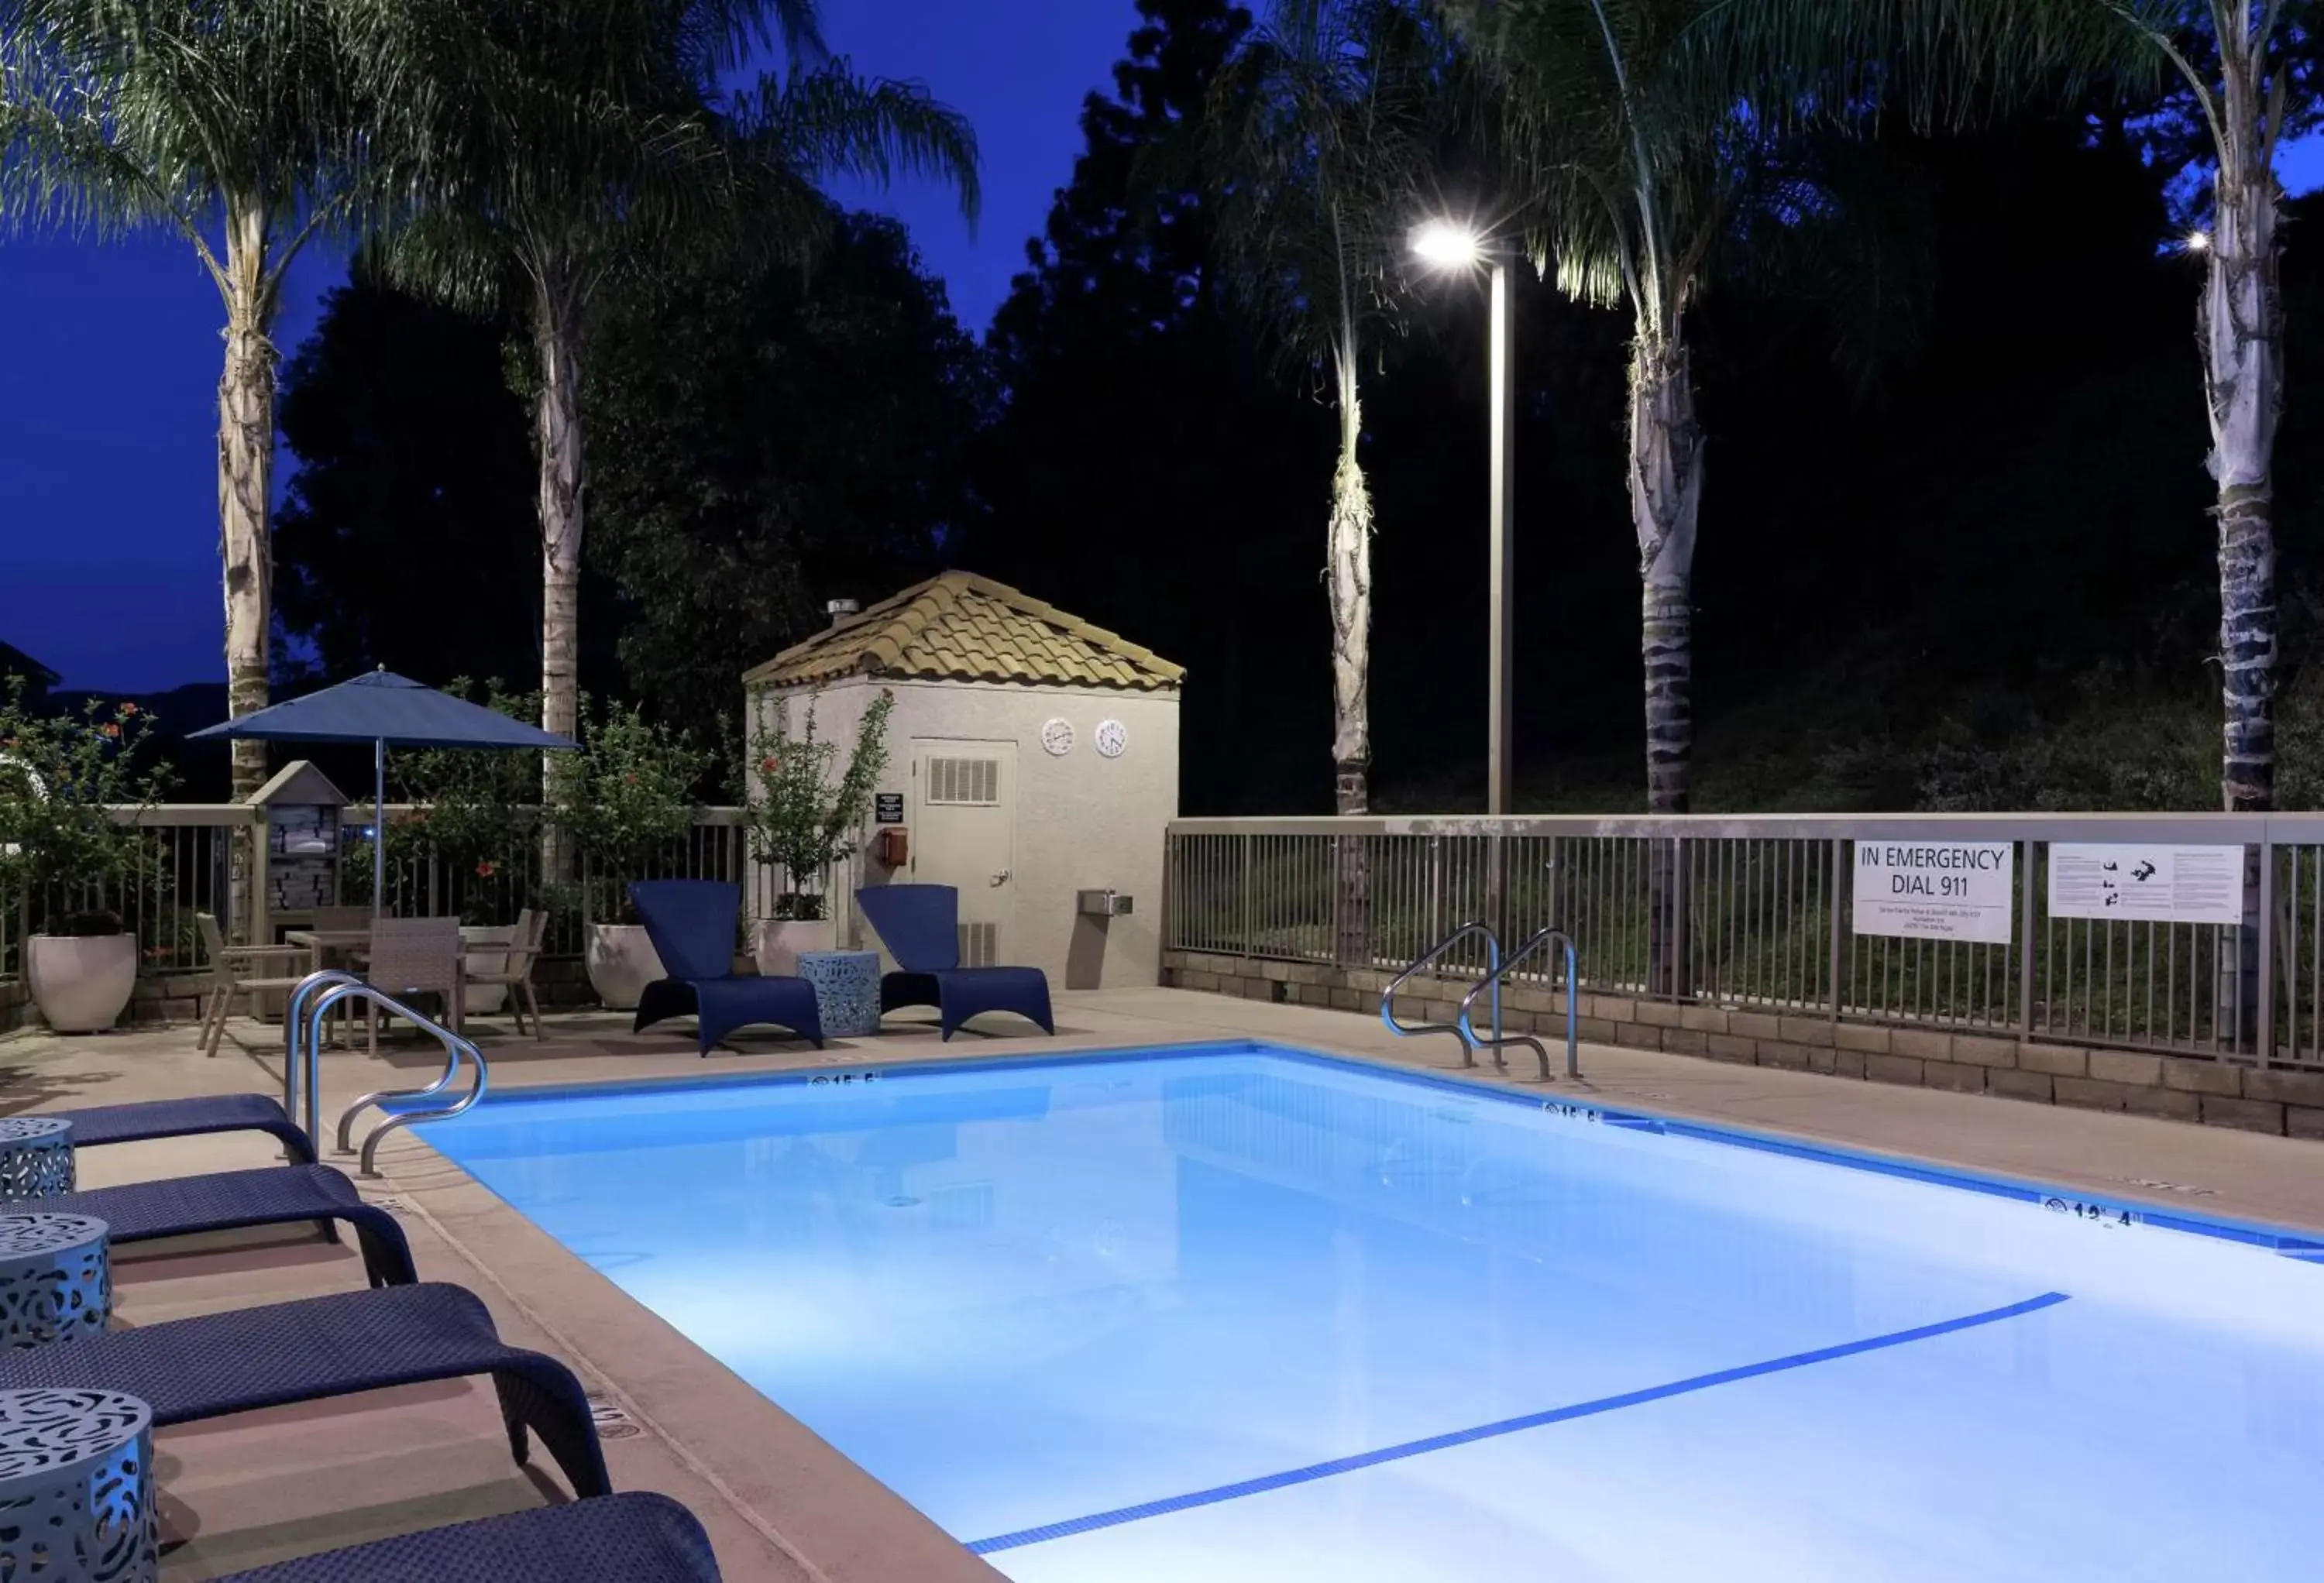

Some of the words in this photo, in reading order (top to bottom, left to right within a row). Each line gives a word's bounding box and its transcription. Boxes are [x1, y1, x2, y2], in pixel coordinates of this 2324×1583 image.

[1862, 847, 1879, 866] IN
[1886, 847, 2005, 870] EMERGENCY
[1892, 874, 1935, 896] DIAL
[1941, 876, 1968, 896] 911
